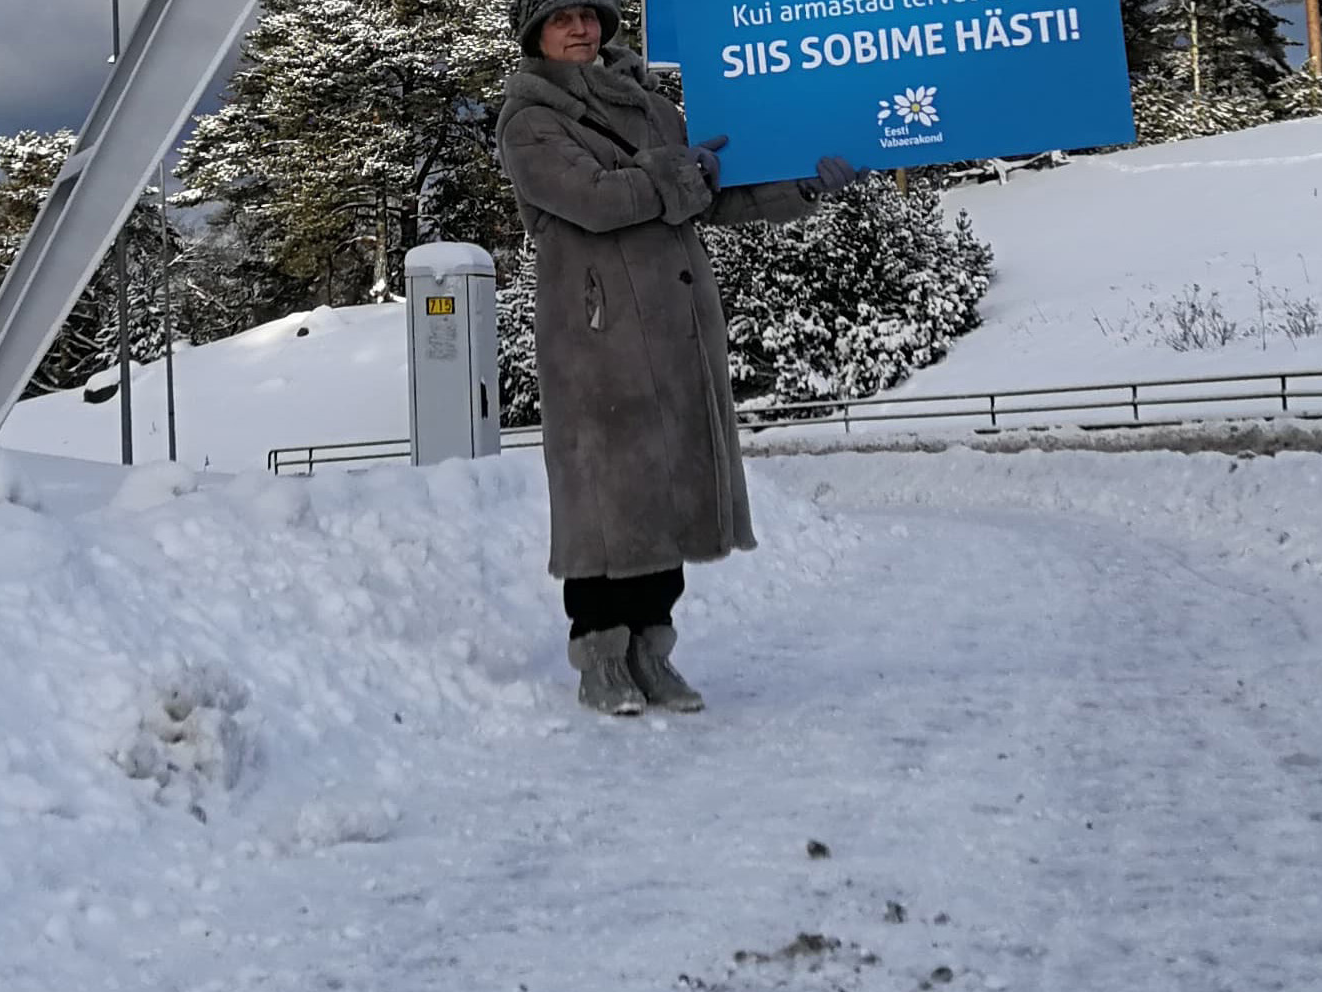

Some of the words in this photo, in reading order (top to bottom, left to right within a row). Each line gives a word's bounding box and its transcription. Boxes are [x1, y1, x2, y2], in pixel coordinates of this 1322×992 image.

[732, 1, 772, 27] Kui
[722, 38, 791, 78] SIIS
[800, 22, 946, 70] SOBIME
[955, 8, 1080, 53] HÄSTI!
[884, 125, 909, 137] Eesti
[430, 299, 452, 313] 715
